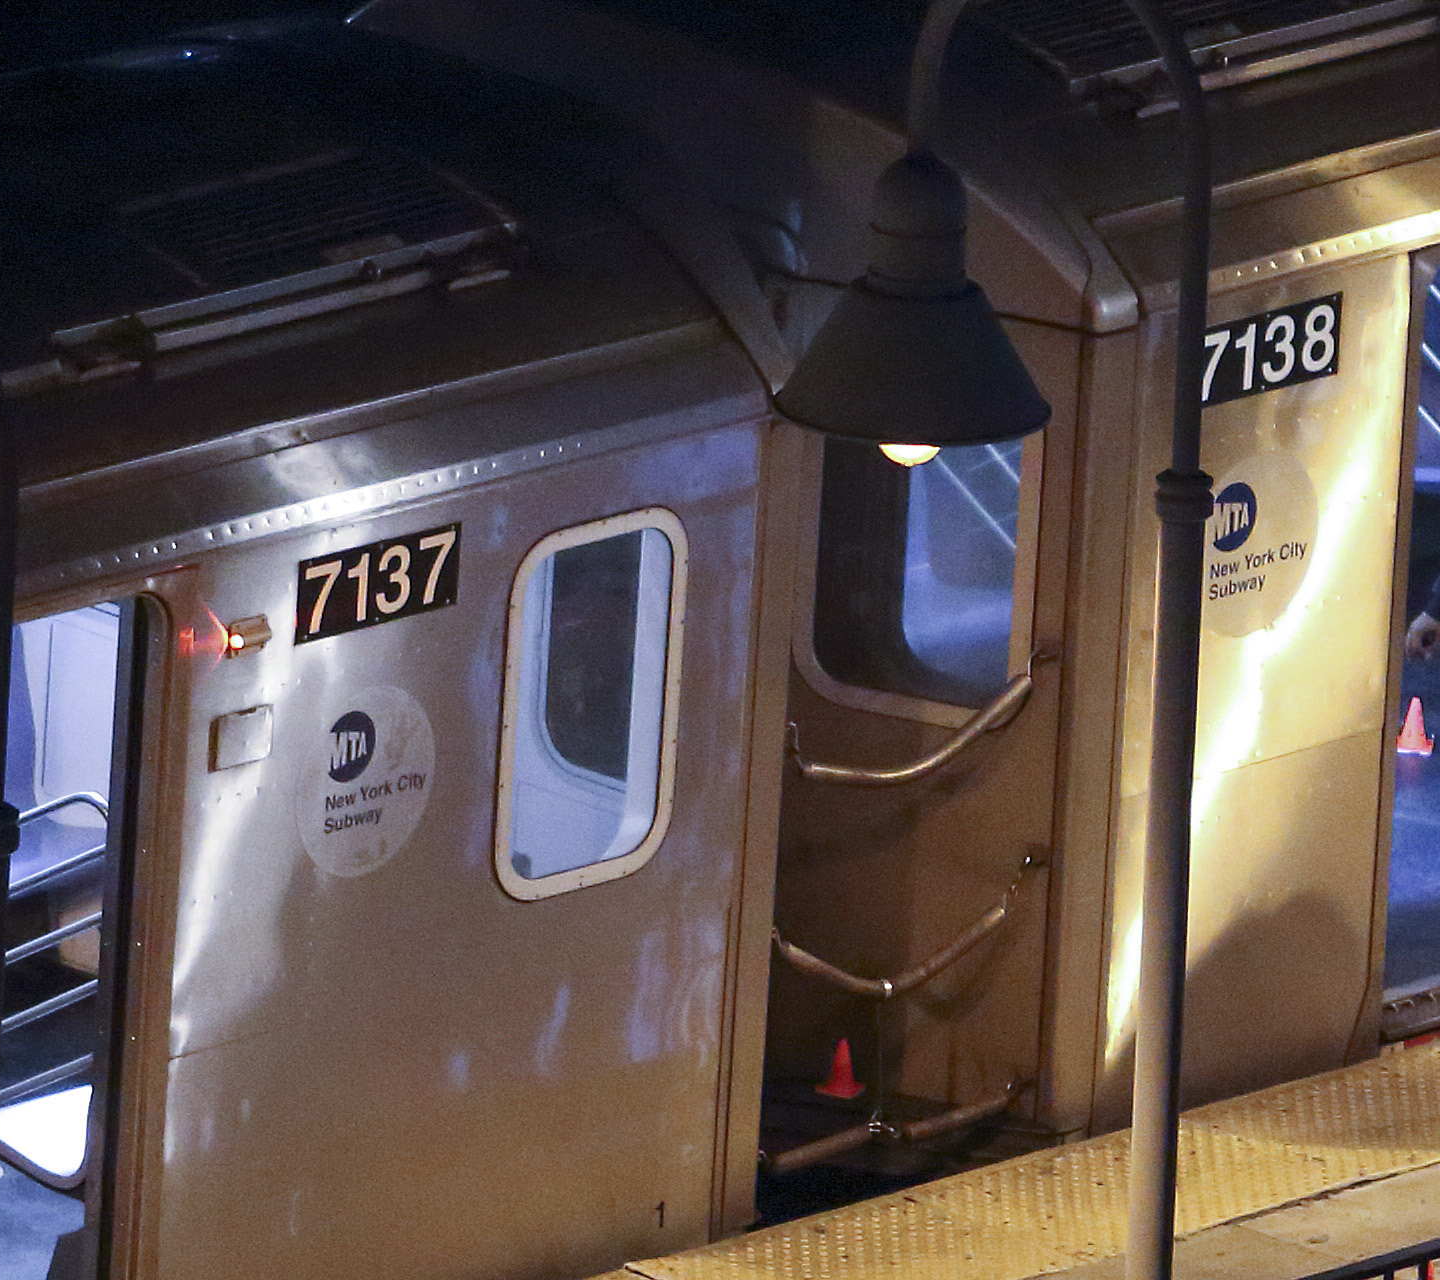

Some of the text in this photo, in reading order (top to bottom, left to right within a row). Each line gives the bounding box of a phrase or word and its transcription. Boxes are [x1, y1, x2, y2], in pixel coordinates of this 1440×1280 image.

[1201, 304, 1335, 402] 7138
[1211, 503, 1249, 541] MTA
[1210, 541, 1308, 580] New York City
[305, 530, 457, 634] 7137
[1208, 574, 1266, 601] Subway
[327, 731, 367, 771] MTA
[325, 772, 427, 812] New York City
[323, 807, 383, 834] Subway
[654, 1200, 665, 1228] 1
